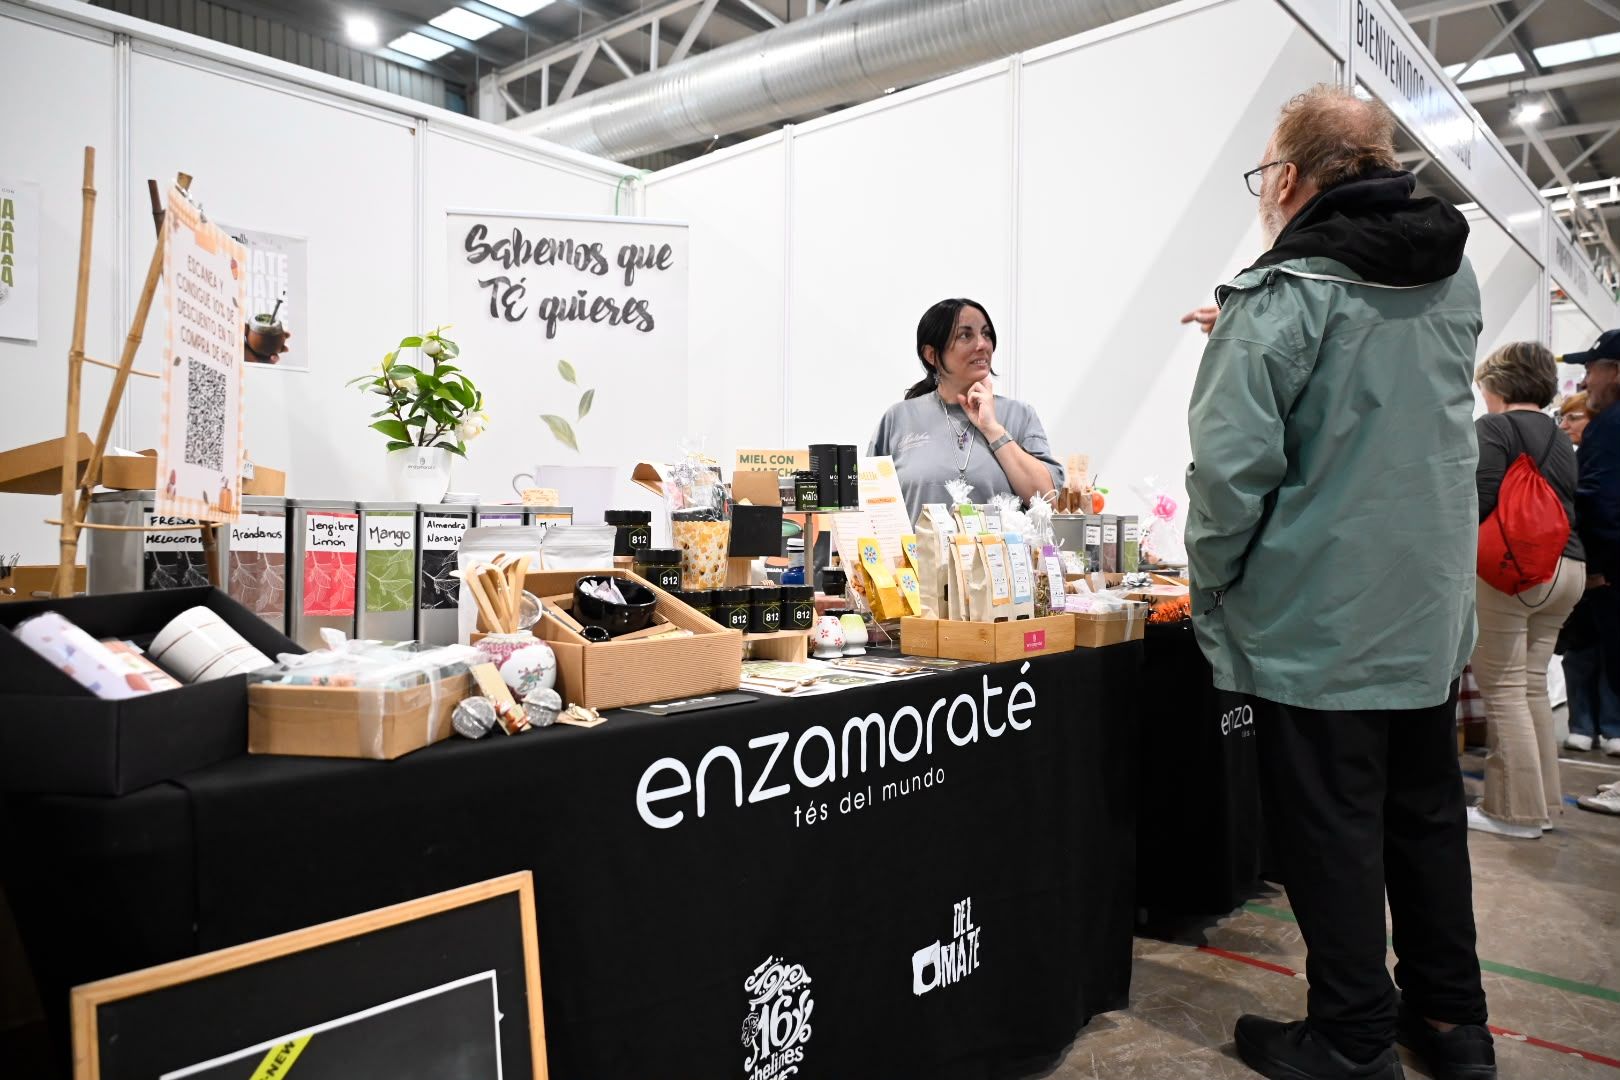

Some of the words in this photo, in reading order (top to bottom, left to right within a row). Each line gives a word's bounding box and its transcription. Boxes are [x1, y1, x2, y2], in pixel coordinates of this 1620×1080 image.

[1356, 0, 1425, 113] BIENVENIDOS
[464, 223, 609, 275] Sabemos
[617, 243, 674, 286] que
[478, 275, 528, 322] TÉ
[538, 290, 655, 340] quieres
[180, 325, 210, 354] COMPRA
[739, 454, 767, 464] MIEL
[769, 455, 794, 465] CON
[308, 518, 354, 536] Jengibre
[426, 520, 466, 530] Almendra
[312, 535, 346, 547] Limón
[369, 526, 411, 548] Mango
[427, 534, 462, 543] Naranja
[631, 535, 647, 544] 812
[662, 576, 678, 585] 812
[732, 614, 747, 624] 812
[765, 612, 779, 622] 812
[796, 610, 810, 619] 812
[635, 660, 1037, 830] enzamoraté
[794, 801, 829, 828] tés
[839, 784, 873, 815] del
[881, 767, 946, 802] mundo
[953, 896, 974, 939] DEL
[940, 926, 981, 988] MATE
